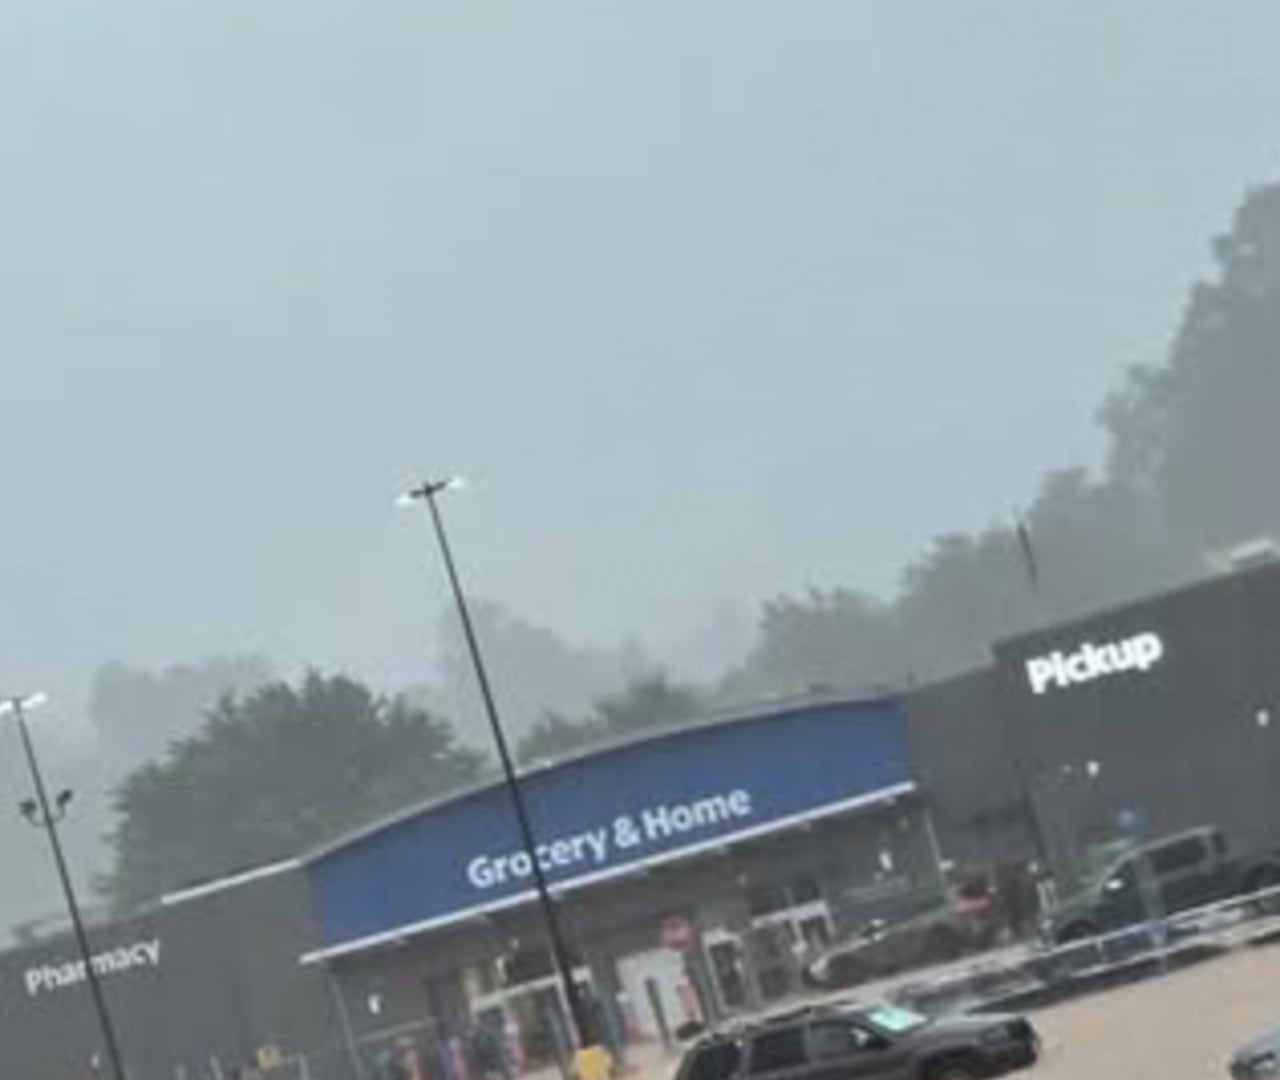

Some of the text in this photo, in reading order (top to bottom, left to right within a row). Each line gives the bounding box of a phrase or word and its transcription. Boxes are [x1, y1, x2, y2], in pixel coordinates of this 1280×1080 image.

[1025, 631, 1163, 694] Pickup
[466, 789, 753, 888] Grocery & Home
[25, 938, 159, 995] Pharmacy
